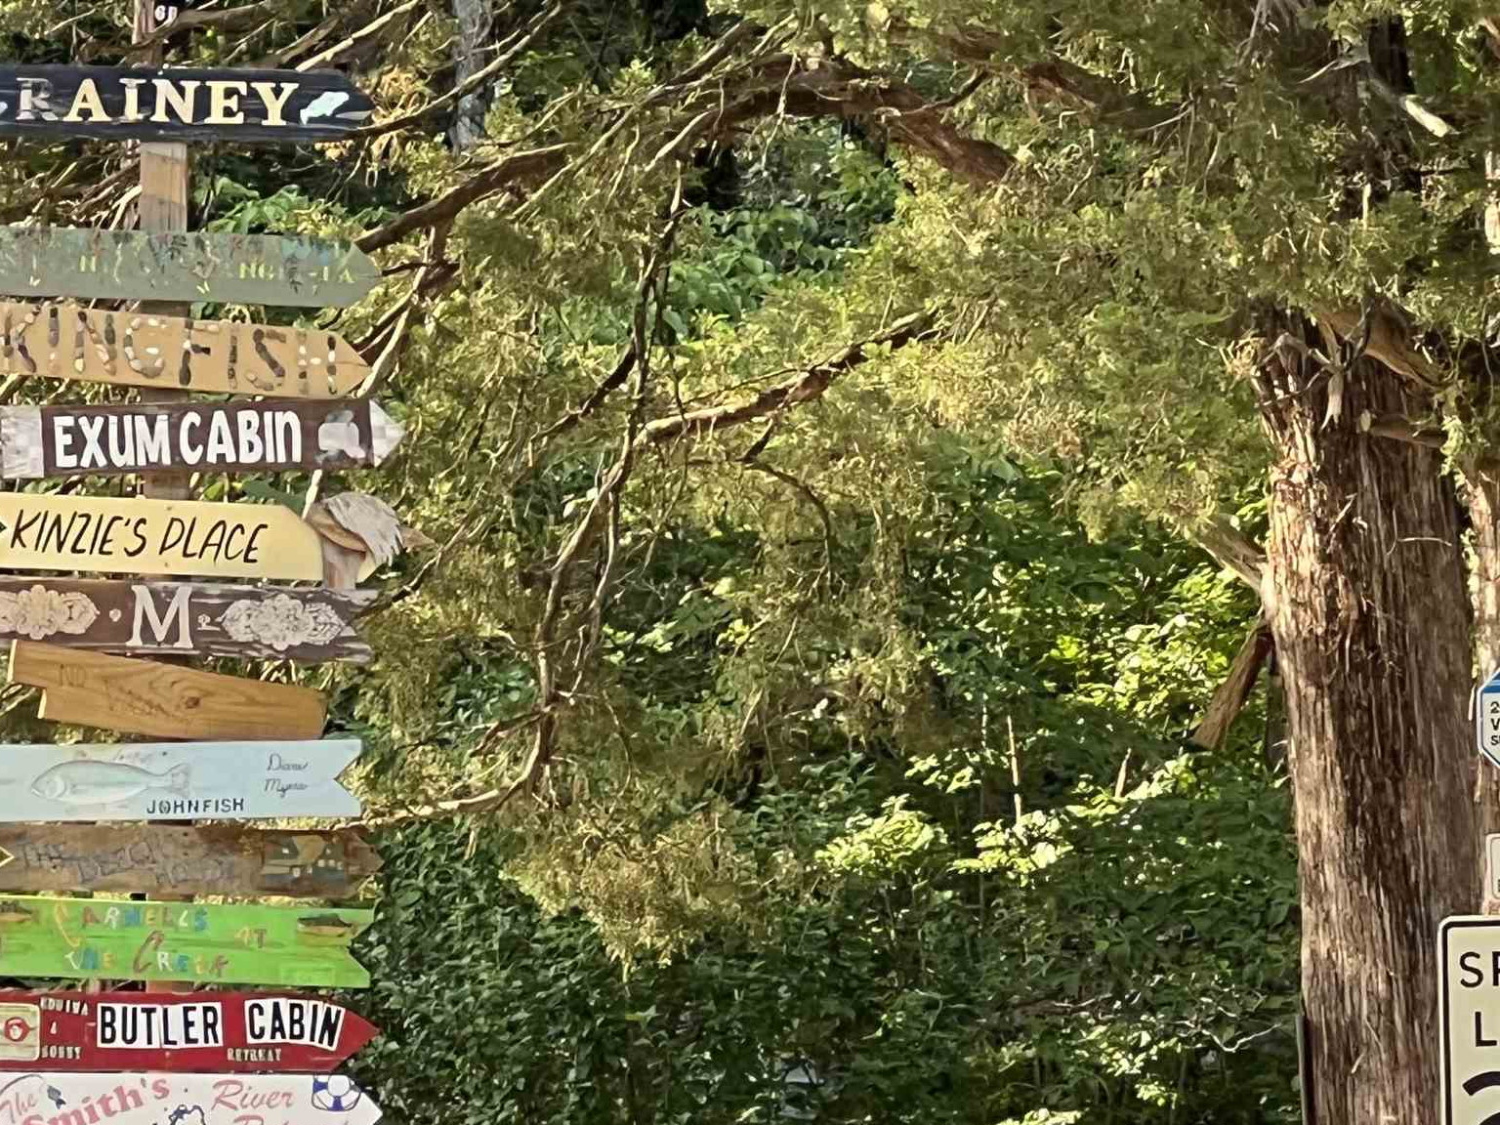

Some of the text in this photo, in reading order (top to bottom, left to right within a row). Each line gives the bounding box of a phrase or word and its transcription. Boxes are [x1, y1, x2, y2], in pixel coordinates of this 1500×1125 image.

[16, 77, 299, 126] RAINEY
[3, 305, 338, 397] KINGFISH
[54, 414, 170, 468] EXUM
[10, 509, 267, 564] KINZIE'S PLACE
[126, 585, 194, 649] M
[100, 1002, 341, 1048] BUTLER CABIN
[211, 1079, 293, 1112] River
